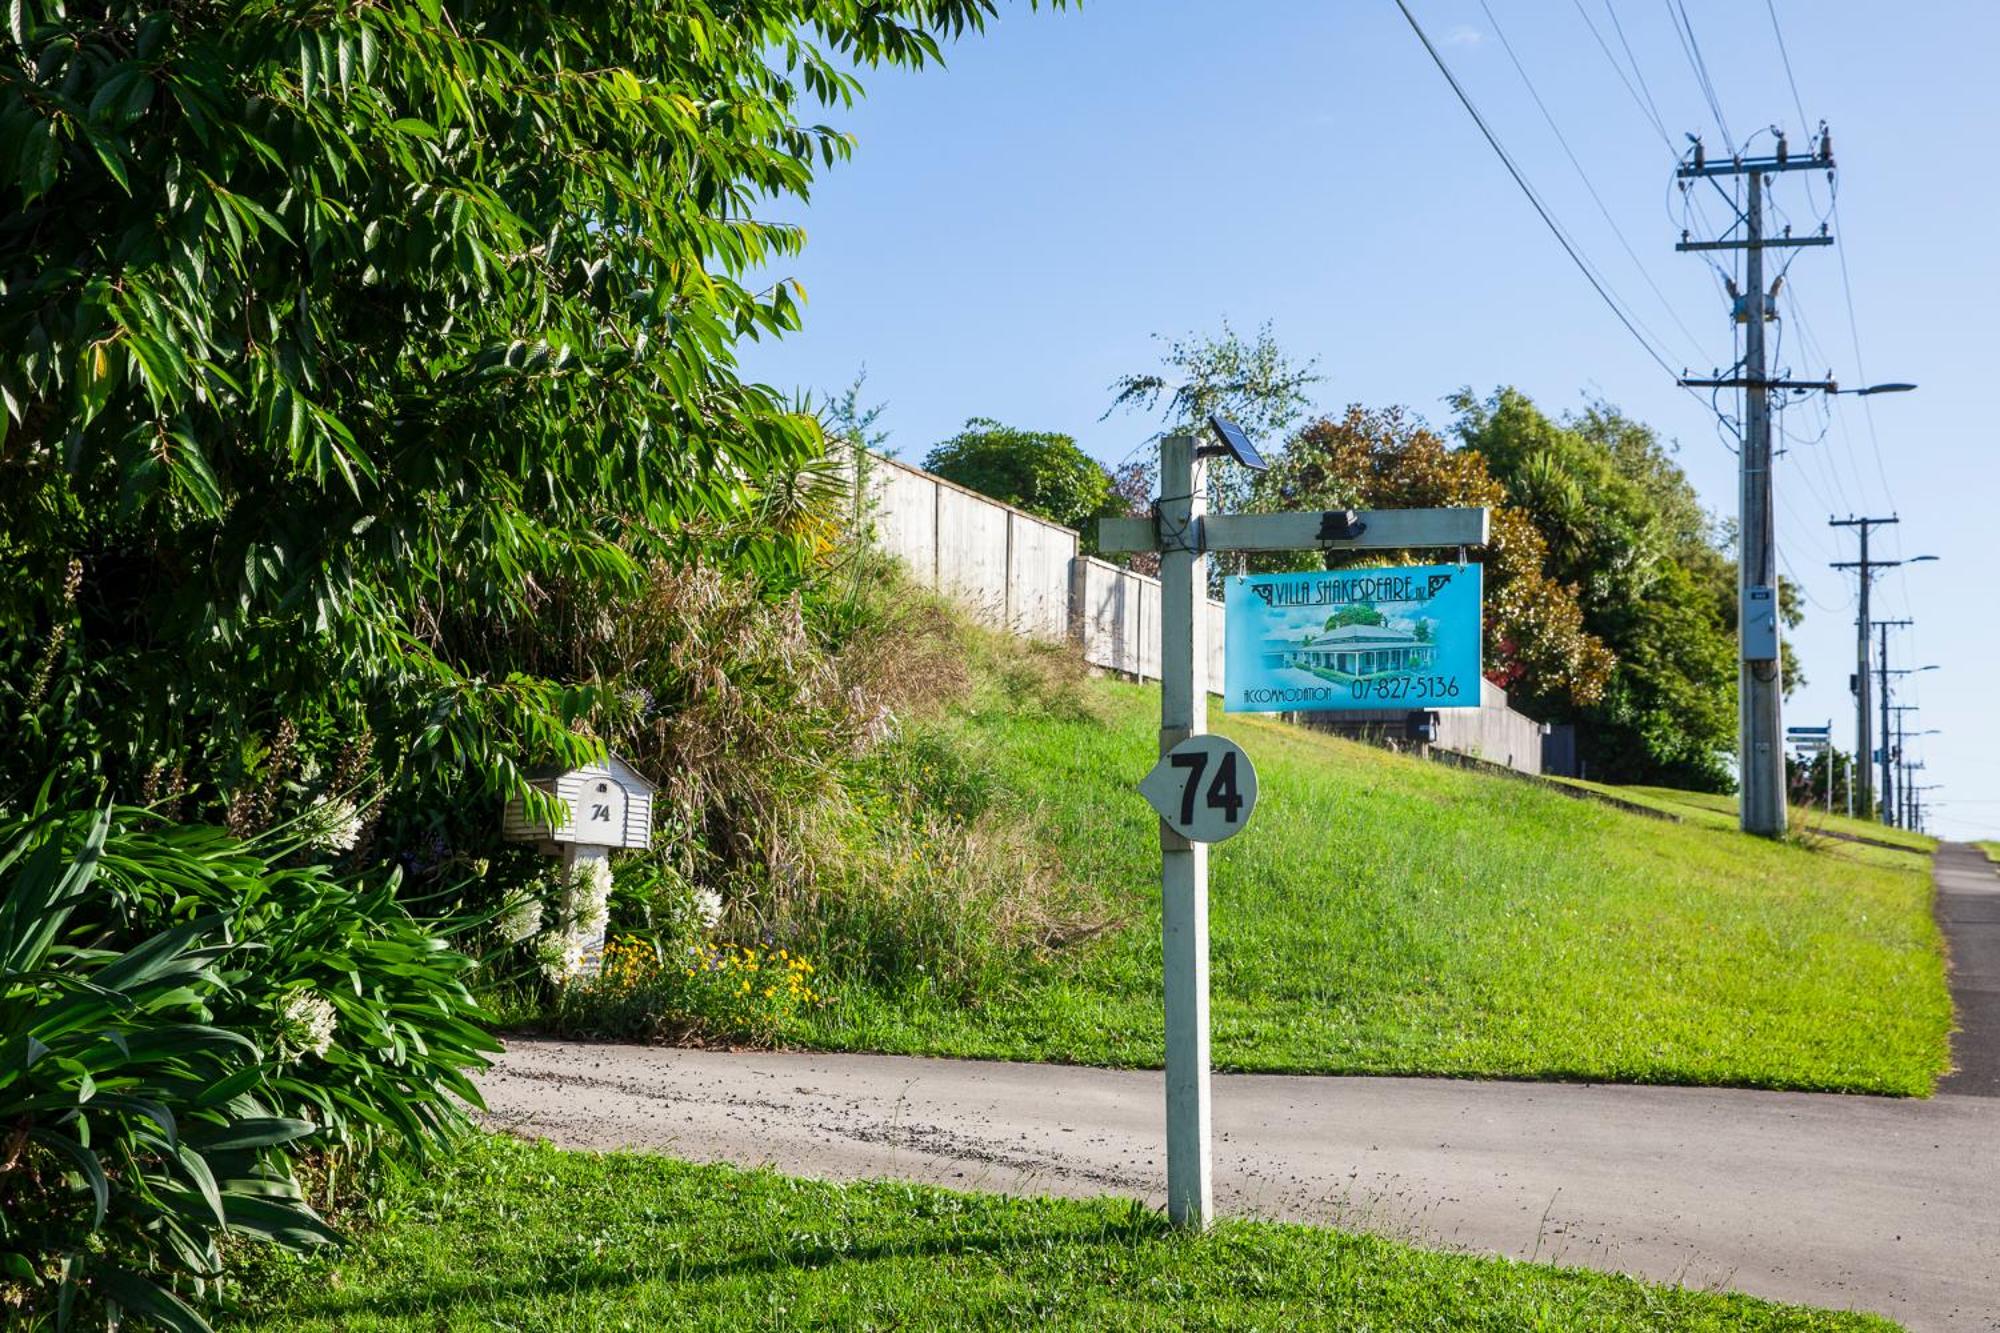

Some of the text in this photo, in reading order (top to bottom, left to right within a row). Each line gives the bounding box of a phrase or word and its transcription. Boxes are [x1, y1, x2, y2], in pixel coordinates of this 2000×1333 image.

[1275, 580, 1311, 604] VILLA
[1316, 576, 1413, 603] SHAKESPEARE
[1243, 687, 1332, 704] ACCOMMODATION
[1352, 676, 1460, 700] 07-827-5136
[1171, 751, 1243, 825] 74
[591, 804, 611, 822] 74
